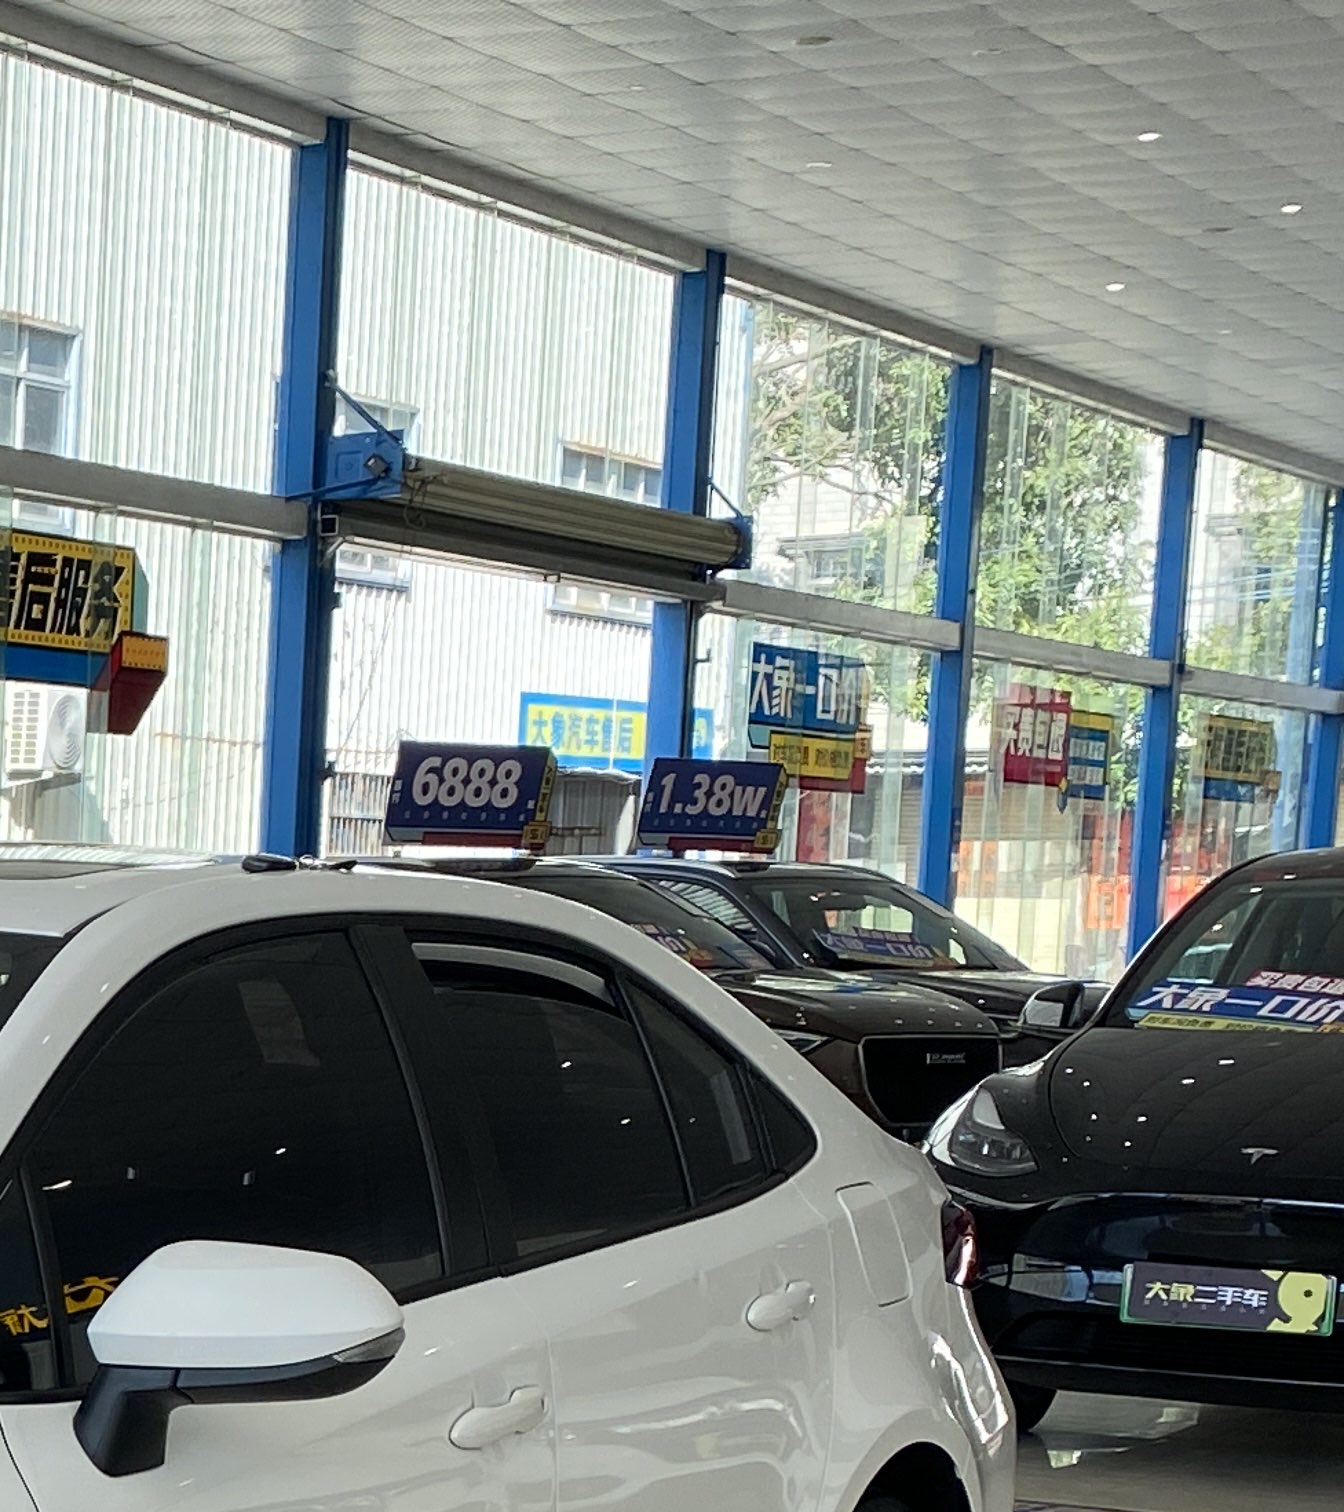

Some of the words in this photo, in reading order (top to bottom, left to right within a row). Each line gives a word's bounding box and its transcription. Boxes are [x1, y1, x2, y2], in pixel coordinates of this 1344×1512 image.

[412, 756, 523, 809] 6888
[1136, 984, 1344, 1024] 大象一口价
[1145, 1281, 1269, 1308] 大象二手车
